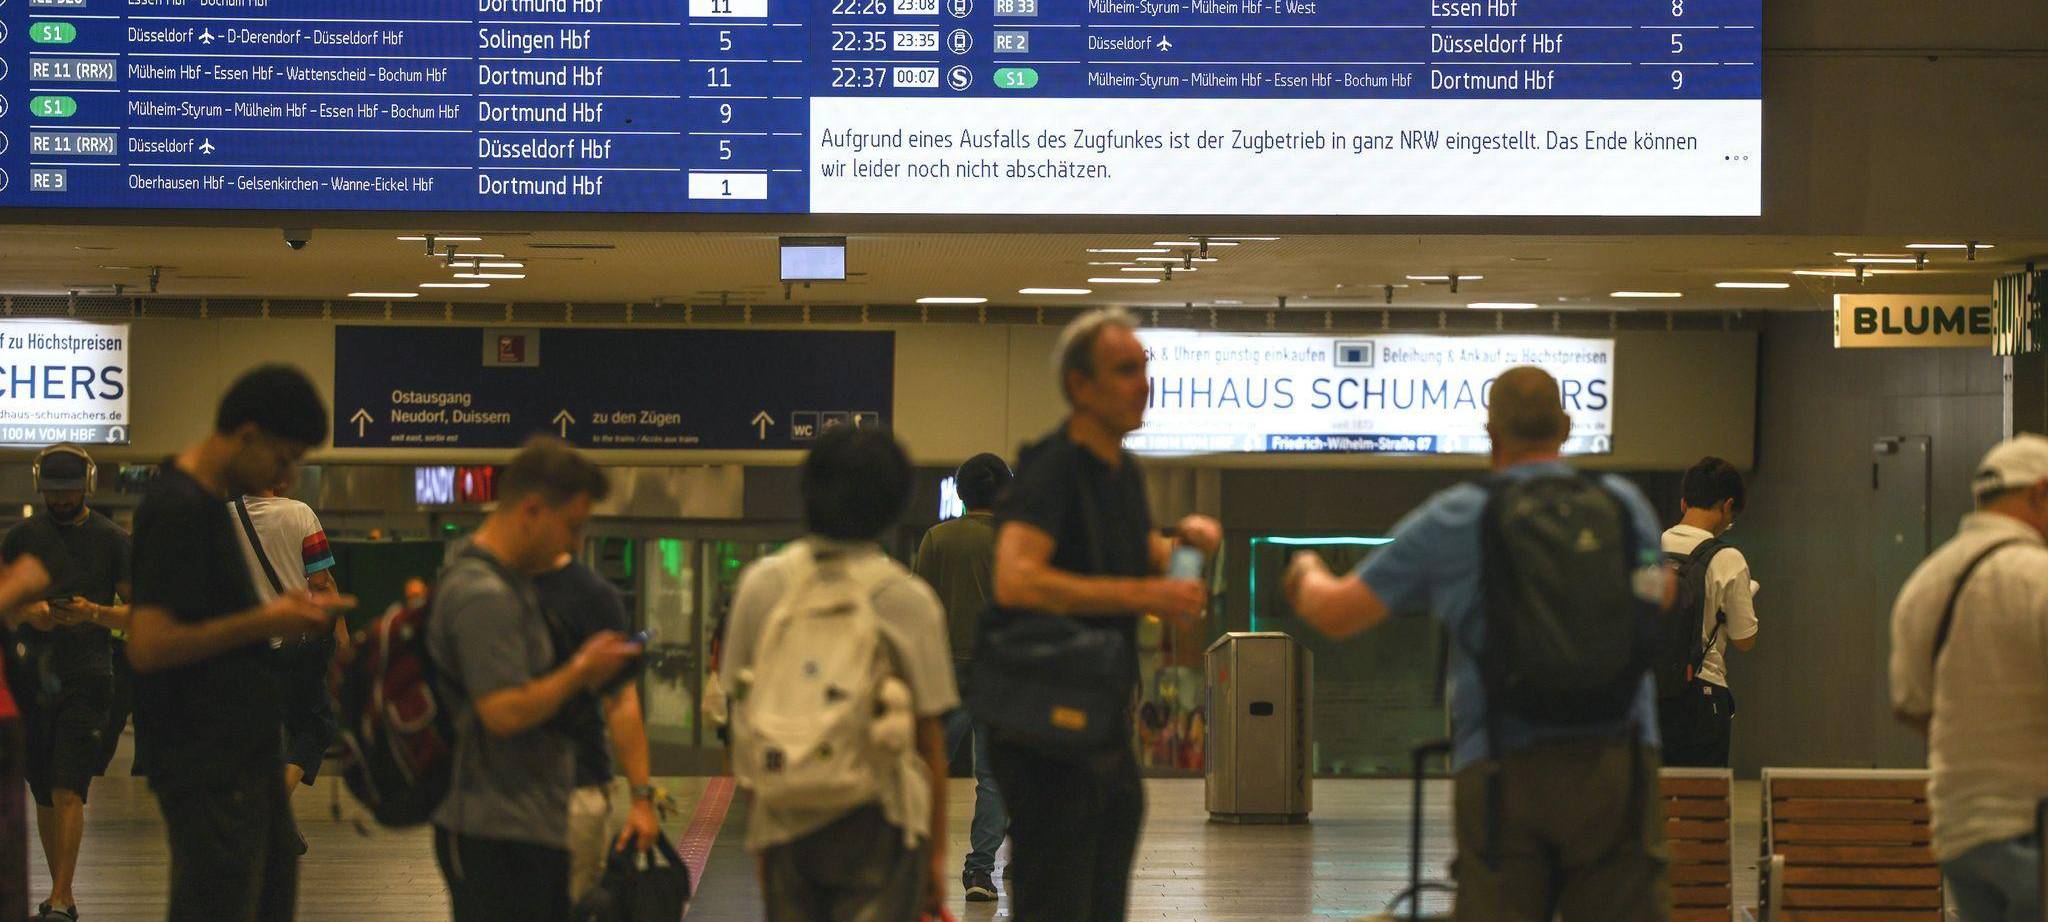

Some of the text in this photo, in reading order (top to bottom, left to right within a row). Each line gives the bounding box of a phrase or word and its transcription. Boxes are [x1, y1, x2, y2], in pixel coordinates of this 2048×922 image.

[479, 0, 603, 12] Dortmund Hbf
[711, 0, 732, 13] 11
[831, 0, 887, 15] 22:26
[897, 0, 935, 10] 23:08
[997, 0, 1035, 12] RB 33
[1088, 0, 1316, 17] Mülheim-Styrum Mülheim Hbf E West
[1431, 0, 1518, 17] Essen Hbf
[1671, 0, 1683, 17] 8
[44, 26, 63, 41] S1
[128, 27, 404, 46] Düsseldorf D-Derendorf Düsseldorf Hbf
[479, 28, 591, 54] Solingen Hbf
[719, 31, 732, 51] 5
[831, 31, 887, 51] 22:35
[897, 34, 935, 47] 23:35
[997, 35, 1026, 49] RE 2
[1088, 36, 1152, 50] Düsseldorf
[1431, 33, 1563, 54] Düsseldorf Hbf
[1671, 33, 1683, 54] 5
[33, 62, 113, 80] RE 11 (RRX)
[128, 63, 448, 82] Mülheim Hbf Essen Hbf Wattenscheid Bochum Hbf
[479, 64, 603, 86] Dortmund Hbf
[707, 67, 732, 88] 11
[831, 67, 887, 88] 22:37
[897, 70, 935, 84] 00:07
[1006, 71, 1025, 86] S1
[1431, 70, 1555, 90] Dortmund Hbf
[1671, 69, 1683, 90] 9
[1088, 72, 1412, 90] Mülheim-Styrum Mülheim Hbf Essen Hbf Bochum Hbf
[44, 99, 63, 115] S1
[128, 100, 460, 119] Mülheim-Styrum Mülheim Hbf Essen Hbf Bochum Hbf
[479, 101, 603, 123] Dortmund Hbf
[719, 104, 732, 124] 9
[33, 136, 114, 154] RE 11 (RRX)
[128, 137, 195, 153] Düsseldorf
[479, 137, 612, 159] Düsseldorf Hbf
[719, 140, 732, 160] 5
[821, 128, 1697, 155] Aufgrund eines Ausfalls des Zugfunkes ist der Zugbetrieb in ganz NRW eingestellt. Das Ende können
[821, 158, 1111, 179] wir leider noch nicht abschätzen.
[33, 173, 63, 188] RE 3
[128, 174, 434, 192] Oberhausen Hbf Gelsenkirchen Wanne-Eickel Hbf
[479, 174, 603, 196] Dortmund Hbf
[721, 178, 732, 197] 1
[1853, 306, 1991, 335] BLUME
[8, 336, 23, 349] zu
[28, 332, 122, 354] Höchstpreisen
[1174, 346, 1210, 361] Uhren
[1264, 347, 1325, 361] einkaufen
[1383, 347, 1443, 365] Beleihung
[1459, 348, 1501, 362] Ankauf
[0, 365, 124, 401] HERS
[391, 389, 472, 407] Ostausgang
[1311, 377, 1609, 411] SCHUMARS
[391, 409, 511, 424] Neudorf, Duissern
[592, 410, 681, 427] zu den Zügen
[39, 427, 67, 441] VOM
[69, 427, 97, 441] HBF
[794, 424, 813, 437] WC
[1271, 436, 1415, 450] Friedrich-Wilhelm-Straße
